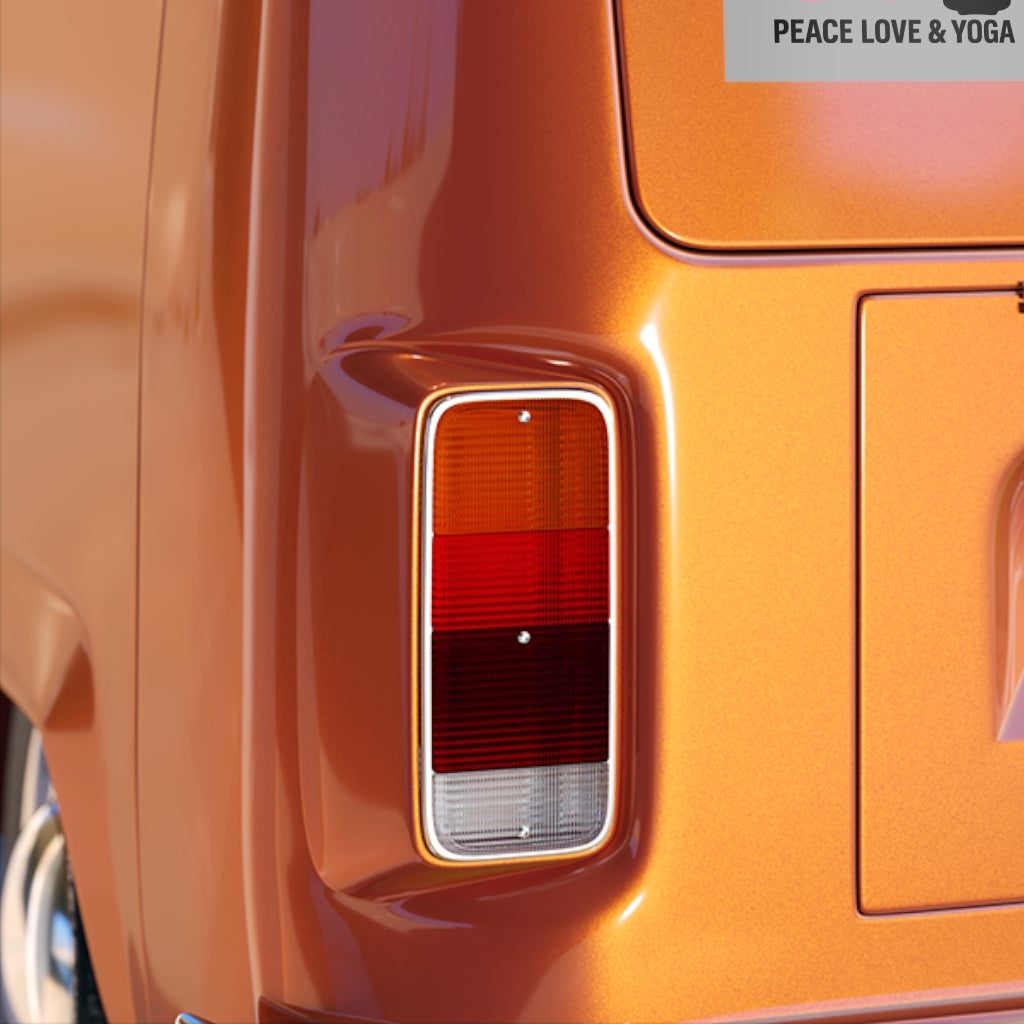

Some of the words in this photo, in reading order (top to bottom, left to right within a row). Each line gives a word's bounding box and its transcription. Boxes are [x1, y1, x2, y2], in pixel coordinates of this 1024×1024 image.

[773, 18, 853, 44] PEACE
[861, 18, 922, 44] LOVE
[928, 18, 947, 44] &
[950, 18, 1016, 44] YOGA
